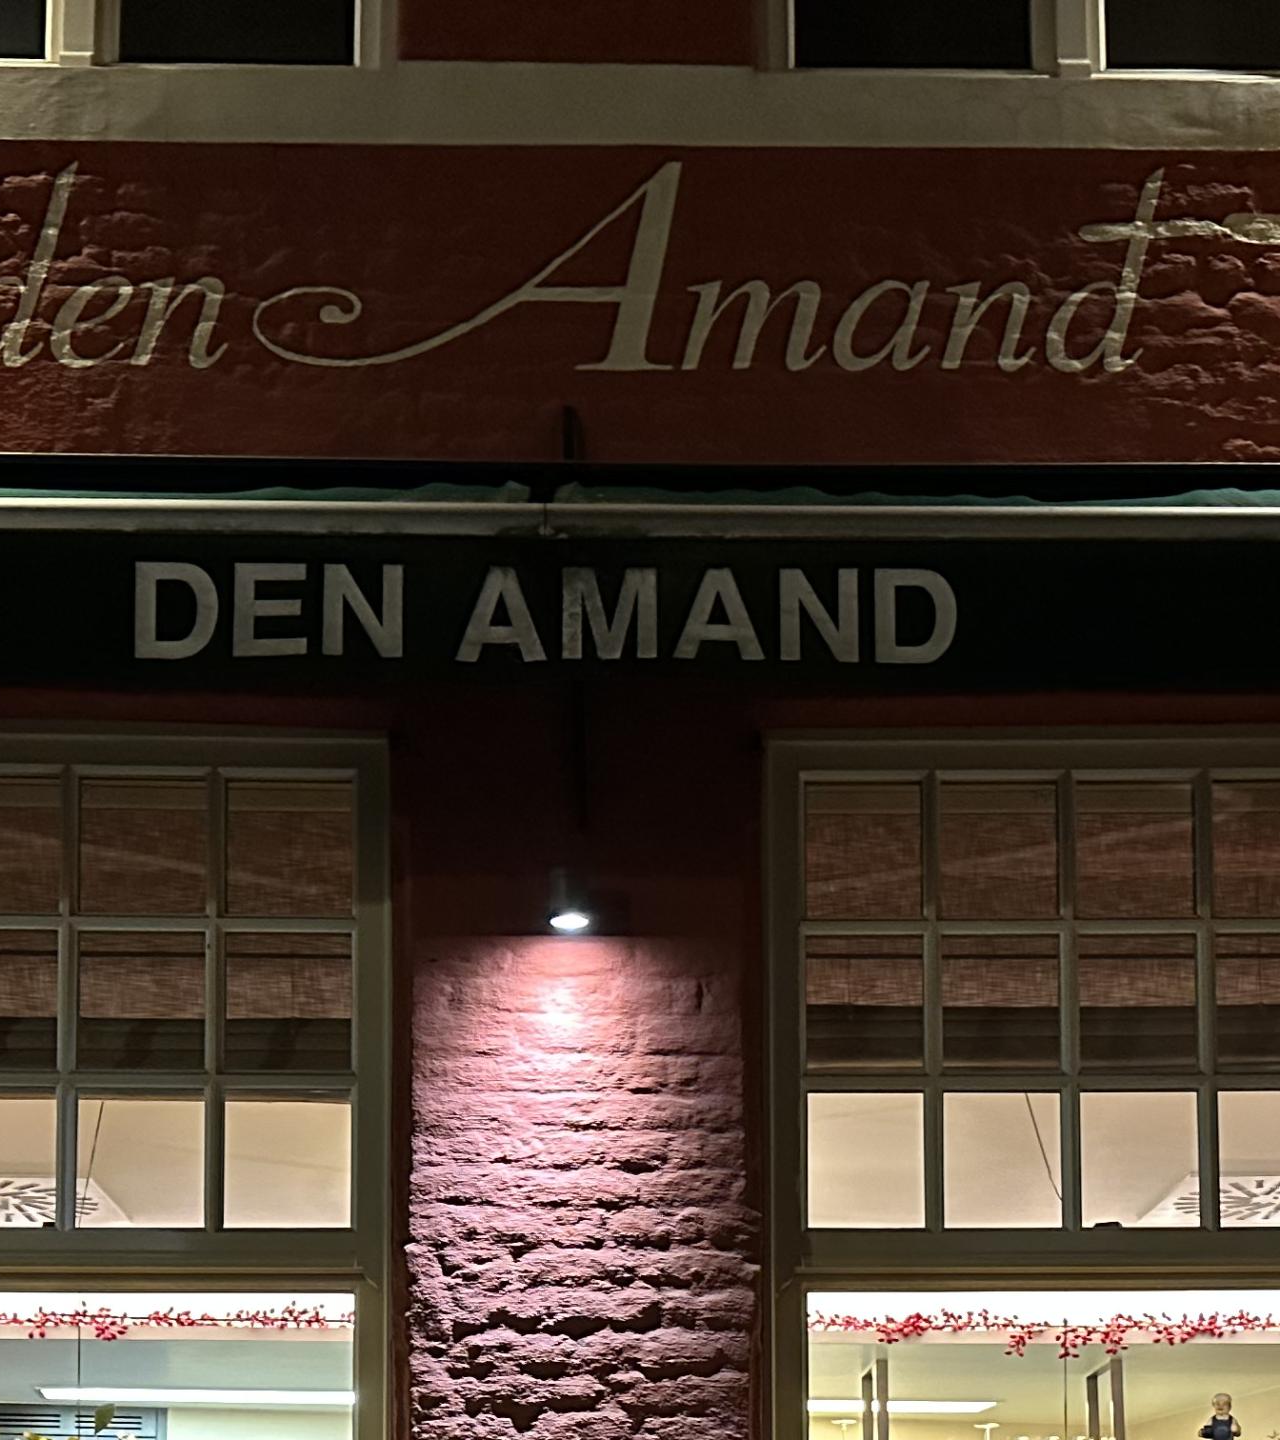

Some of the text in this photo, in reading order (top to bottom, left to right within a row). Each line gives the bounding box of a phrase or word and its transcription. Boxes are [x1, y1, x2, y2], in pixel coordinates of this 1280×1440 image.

[260, 159, 1160, 373] Amand
[133, 560, 960, 665] DEN AMAND
